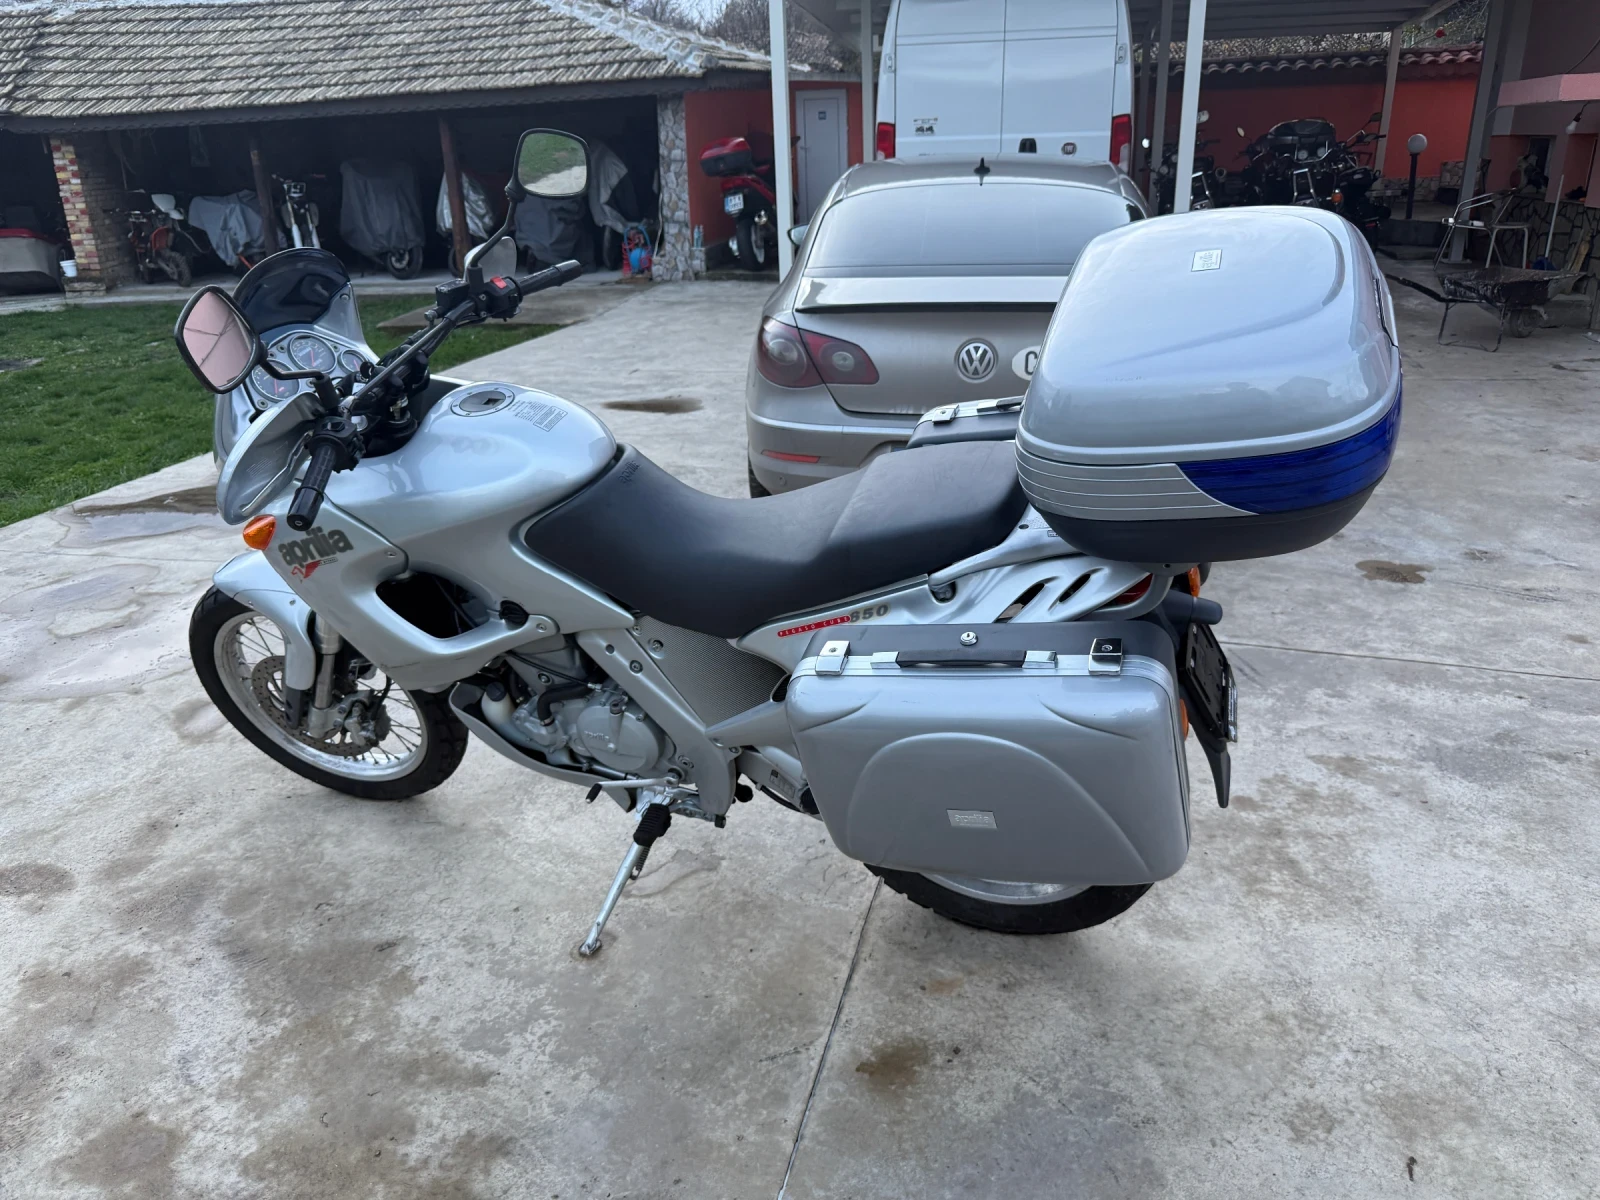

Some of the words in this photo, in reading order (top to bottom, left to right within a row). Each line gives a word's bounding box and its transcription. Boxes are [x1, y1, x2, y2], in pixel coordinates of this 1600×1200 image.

[278, 526, 354, 569] aprilia
[779, 624, 816, 637] PEGASO
[849, 604, 889, 623] 650
